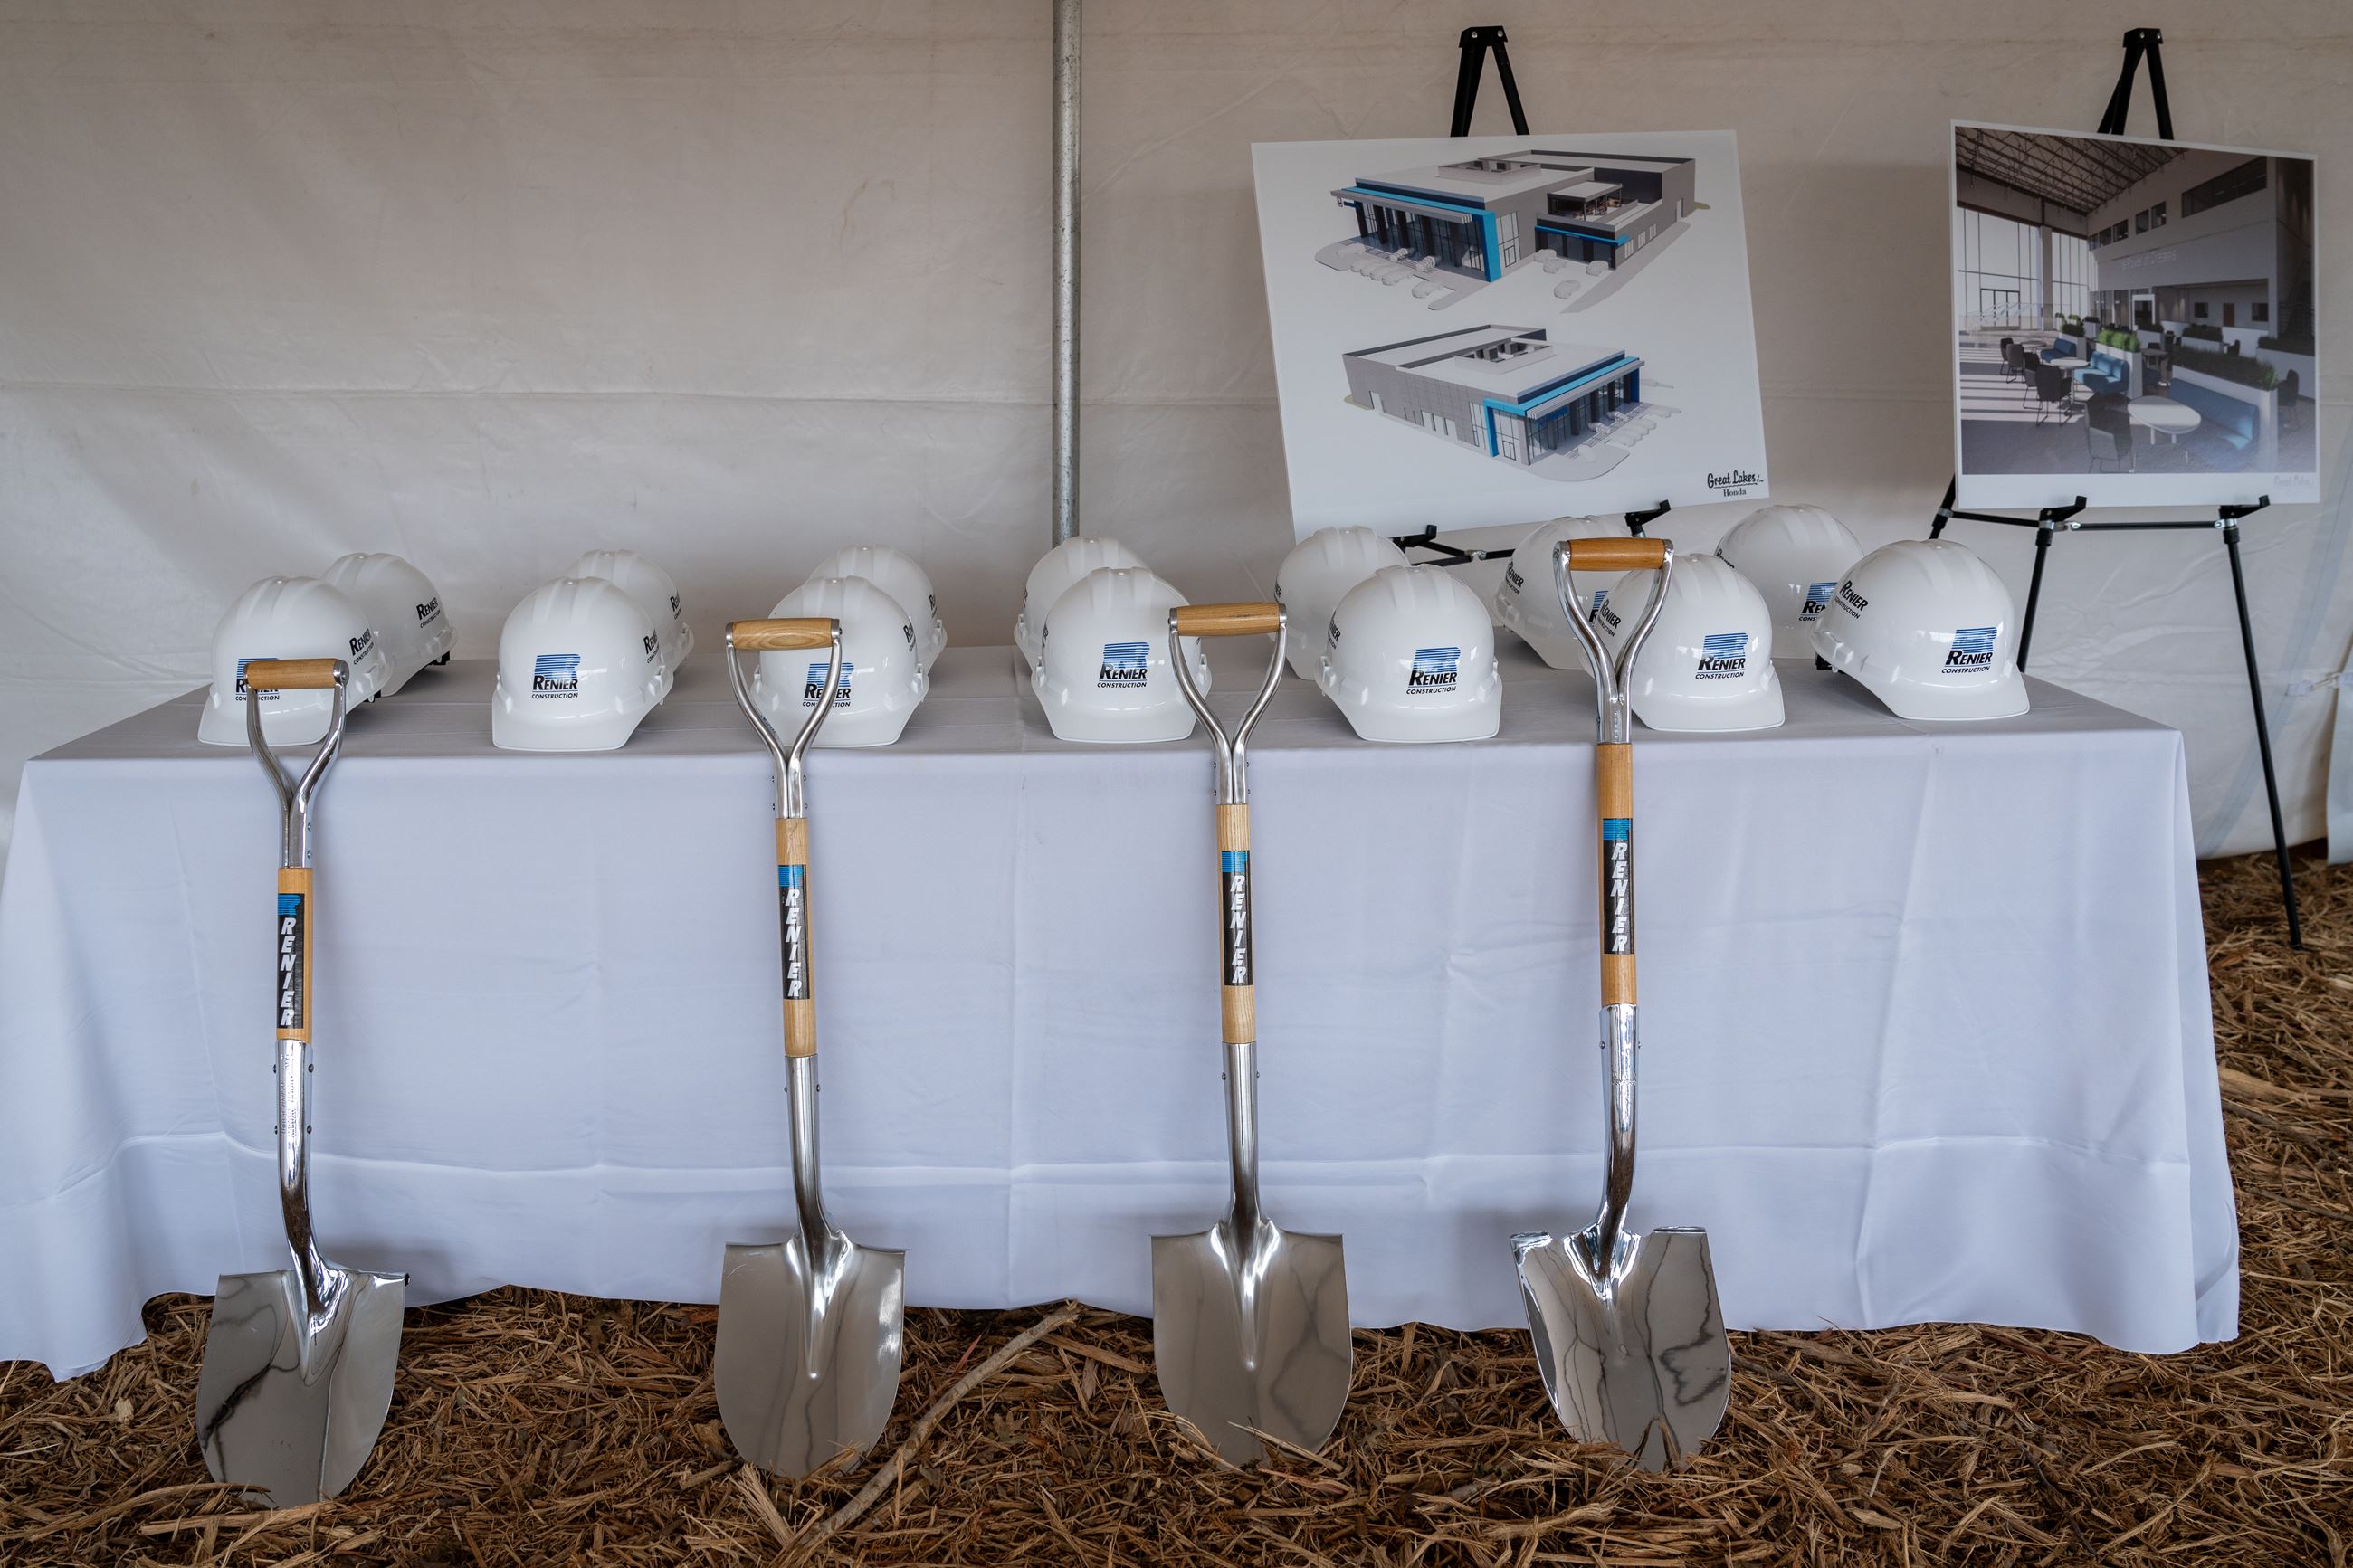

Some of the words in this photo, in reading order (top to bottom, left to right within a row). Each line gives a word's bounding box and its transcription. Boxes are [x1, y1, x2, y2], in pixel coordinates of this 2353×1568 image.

[1707, 472, 1731, 489] Great
[1732, 470, 1757, 484] Lakes
[1723, 488, 1748, 497] Honda
[1839, 580, 1869, 612] RENIER
[415, 596, 439, 621] RENIER
[1599, 598, 1622, 629] RENIER
[1698, 653, 1746, 670] RENIER
[1945, 650, 1993, 665] RENIER
[1100, 663, 1148, 679] RENIER
[1695, 671, 1745, 679] CONSTRUCTION
[1941, 665, 1991, 674] CONSTRUCTION
[532, 675, 578, 690] RENIER
[1408, 670, 1458, 686] RENIER
[804, 683, 852, 699] REER
[1406, 686, 1457, 695] CONSTRUCTION
[1610, 842, 1629, 952] RENIER
[1229, 875, 1247, 984] RENIER
[785, 889, 803, 997] RENIER
[280, 917, 297, 1026] RENIER
